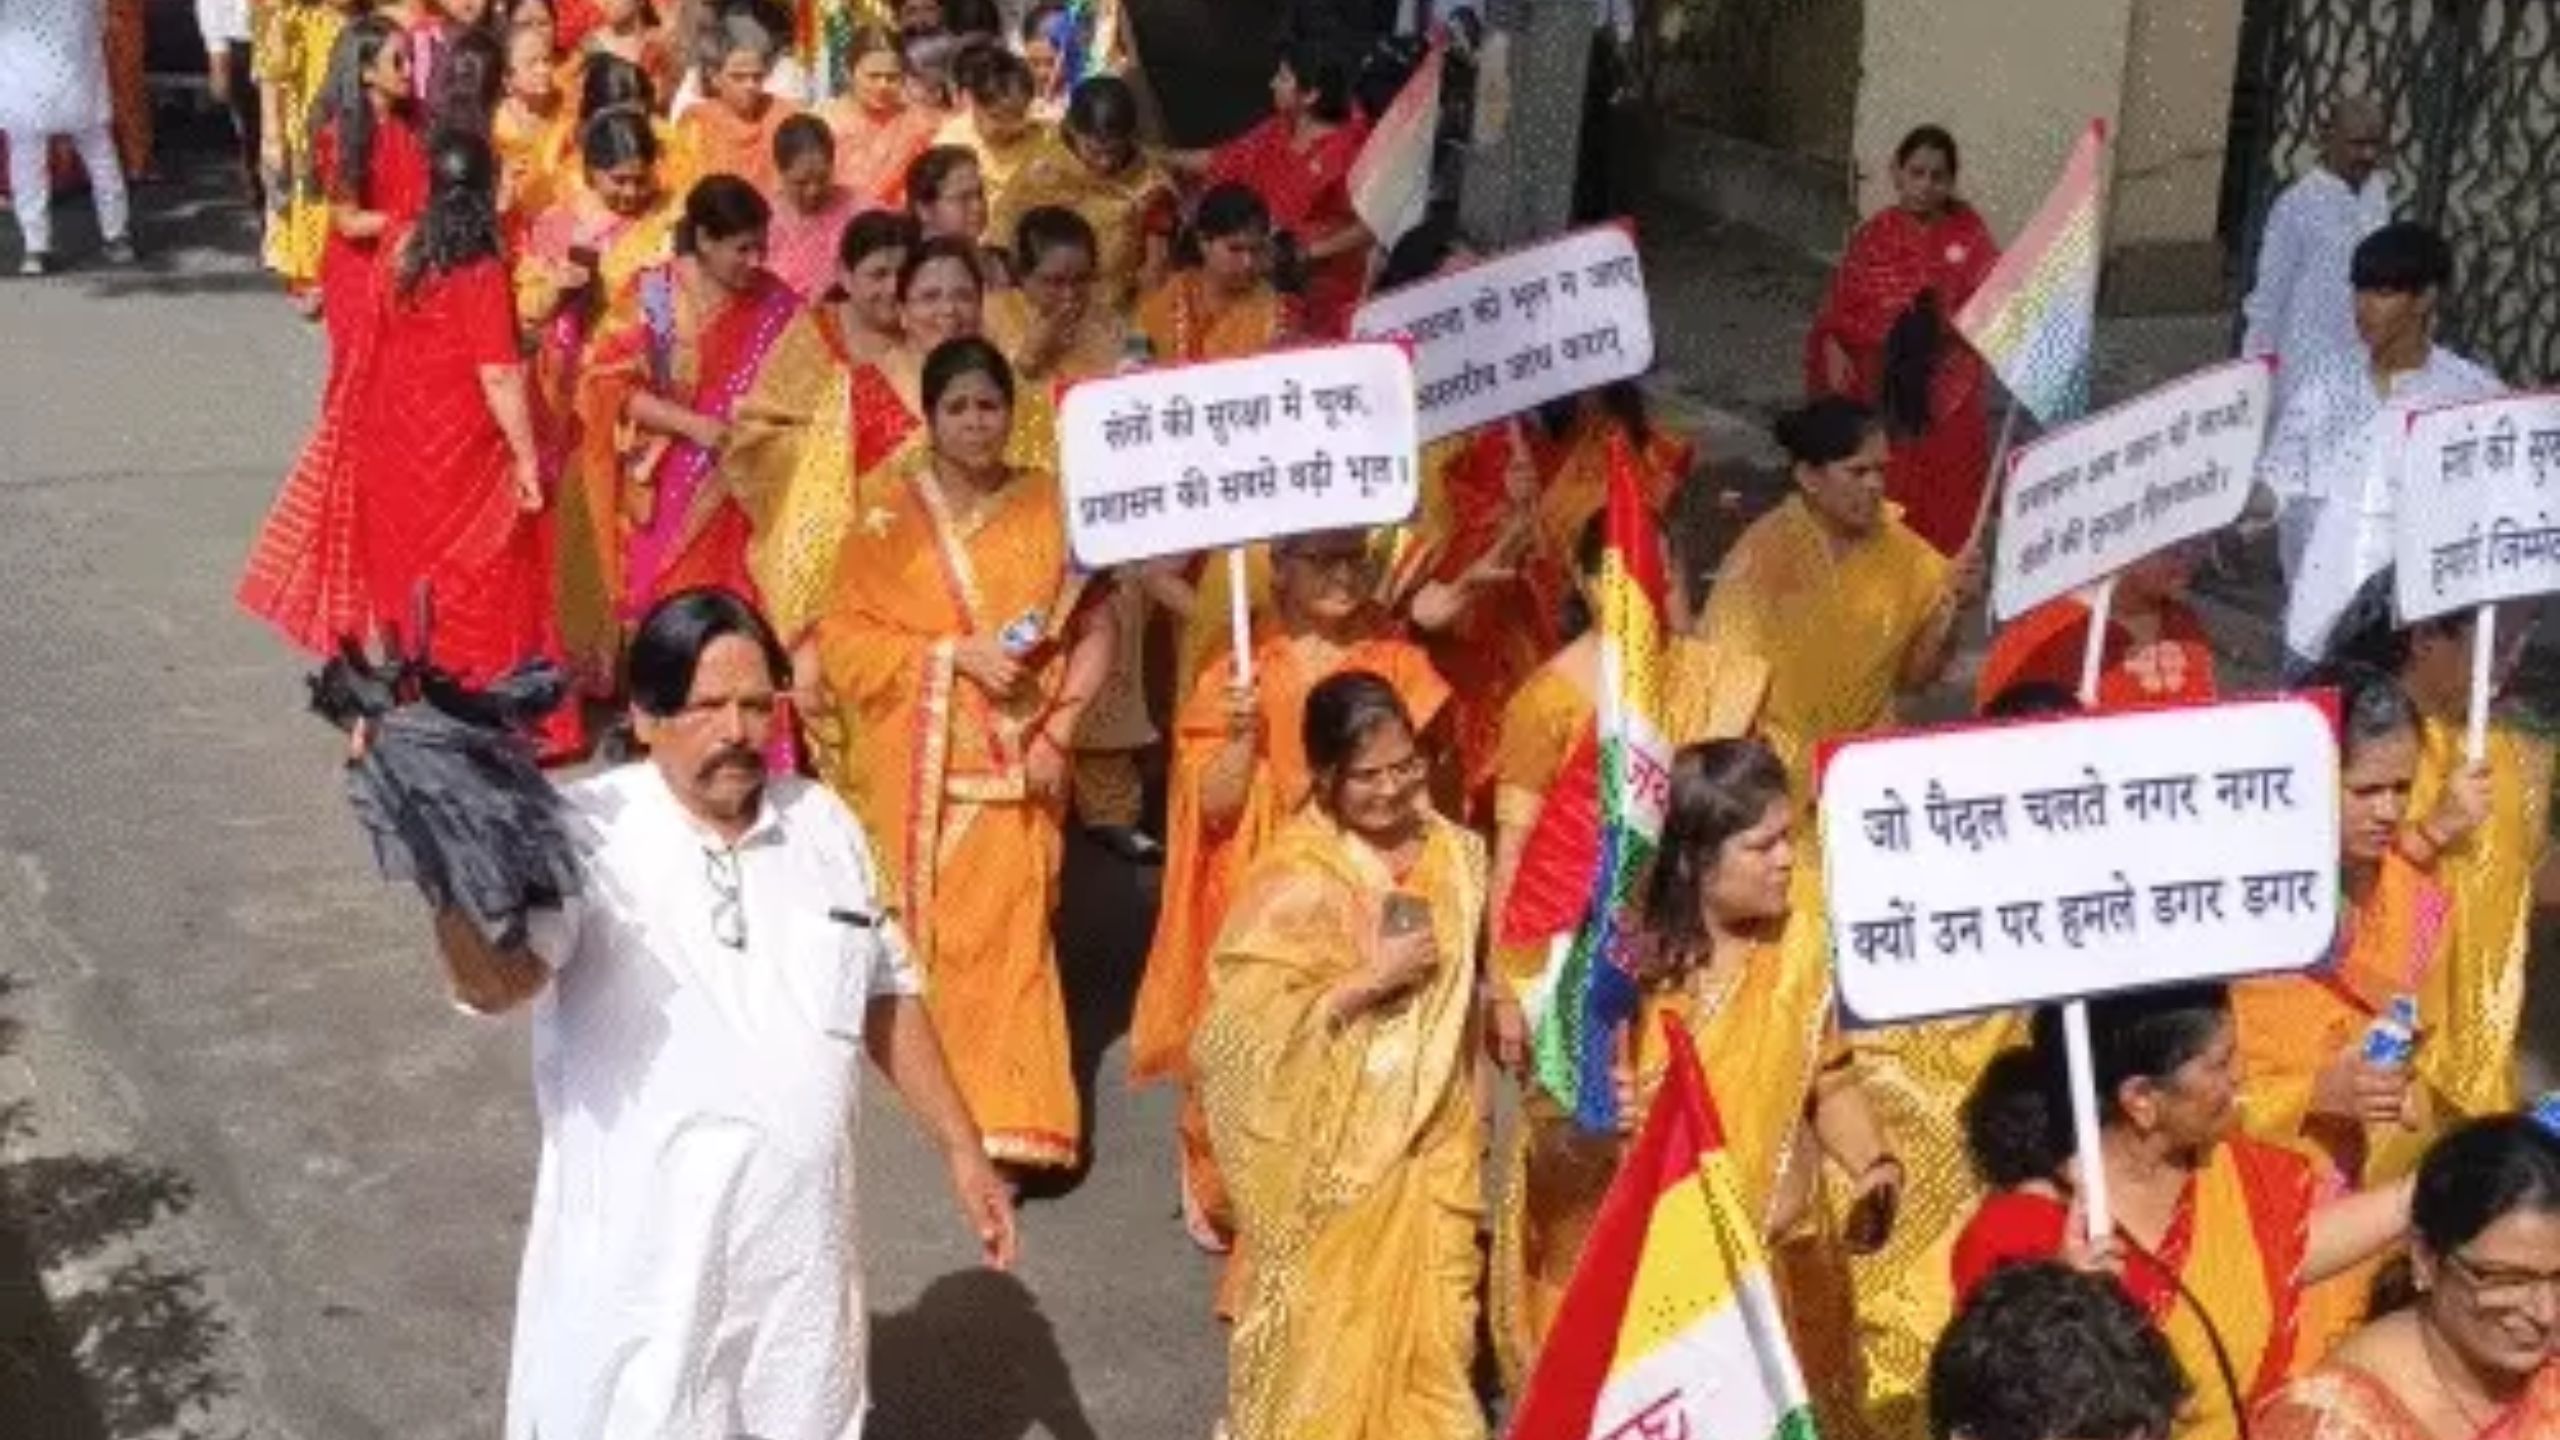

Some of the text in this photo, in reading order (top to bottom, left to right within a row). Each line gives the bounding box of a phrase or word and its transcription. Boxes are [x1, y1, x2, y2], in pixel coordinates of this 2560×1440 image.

[1160, 394, 1194, 438] की
[1204, 393, 1271, 446] सुरक्षा
[1279, 377, 1302, 422] में
[1174, 465, 1209, 509] की
[1862, 765, 2297, 852] जो पैदल चलते नगर नगर
[1850, 868, 2319, 965] क्यों उन पर हमले डगर डगर
